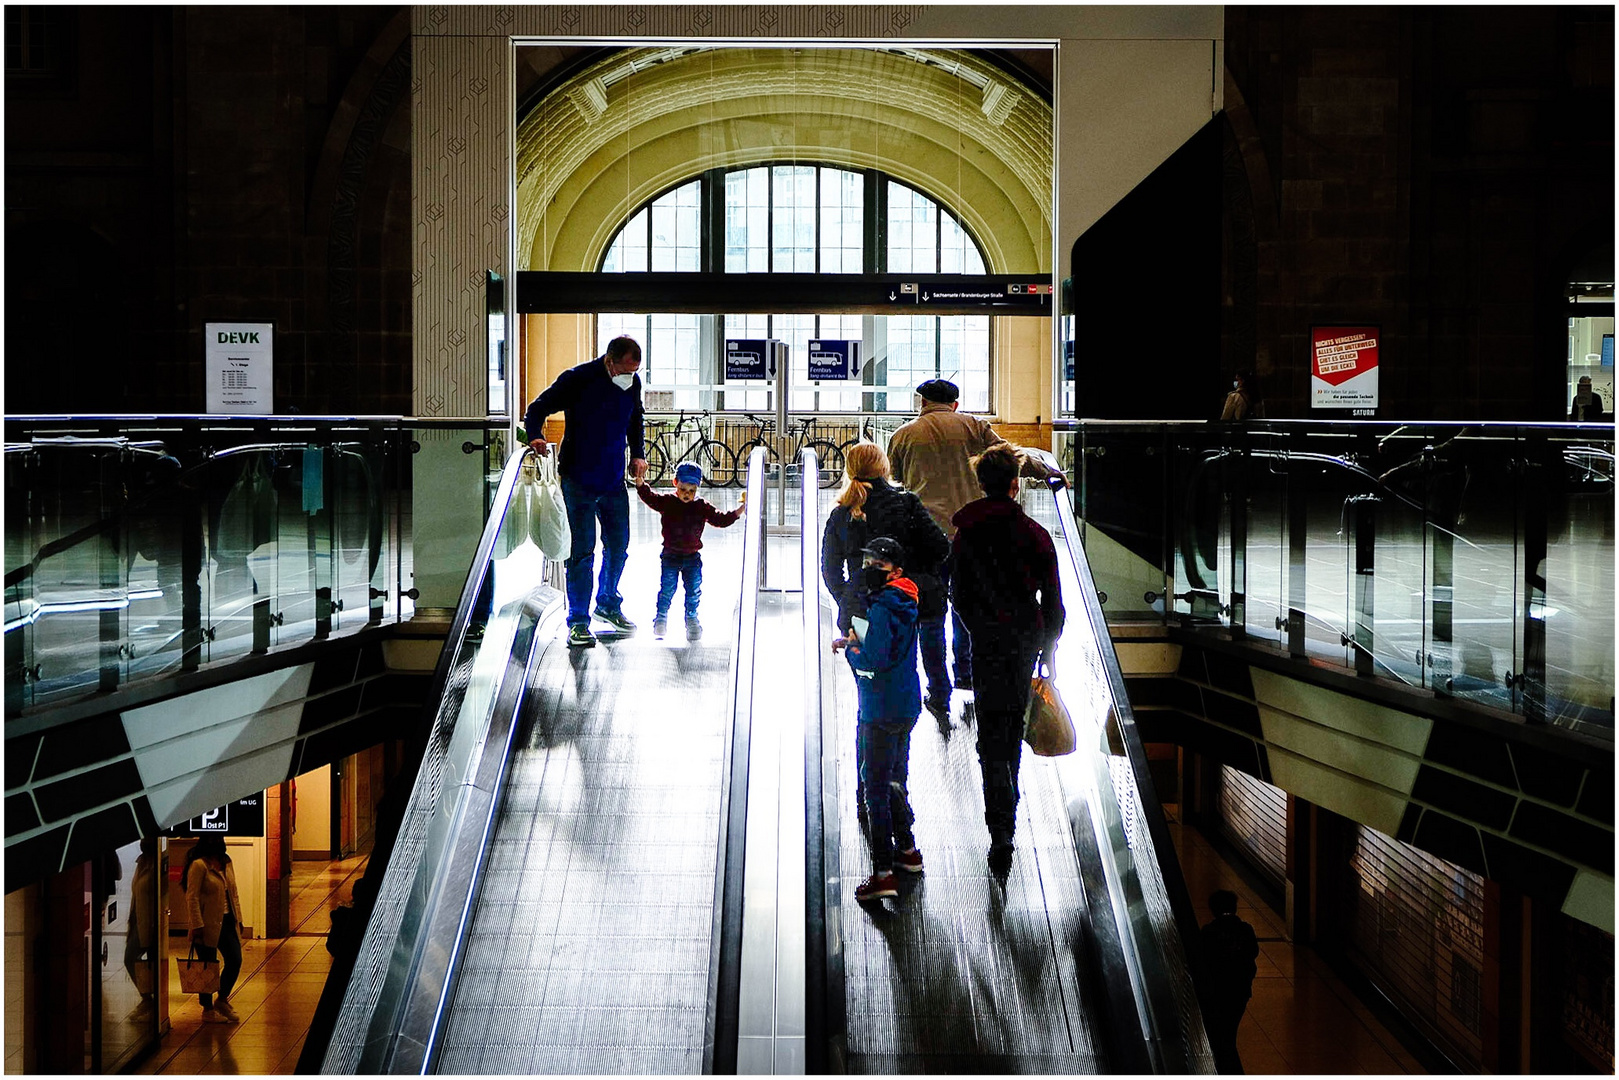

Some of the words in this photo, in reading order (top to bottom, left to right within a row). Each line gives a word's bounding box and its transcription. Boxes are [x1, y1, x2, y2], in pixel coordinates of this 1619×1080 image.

[218, 332, 259, 344] DEVK
[1335, 334, 1366, 344] VERGESSEN?
[1344, 340, 1375, 350] UNTERWEGS
[202, 808, 219, 828] P
